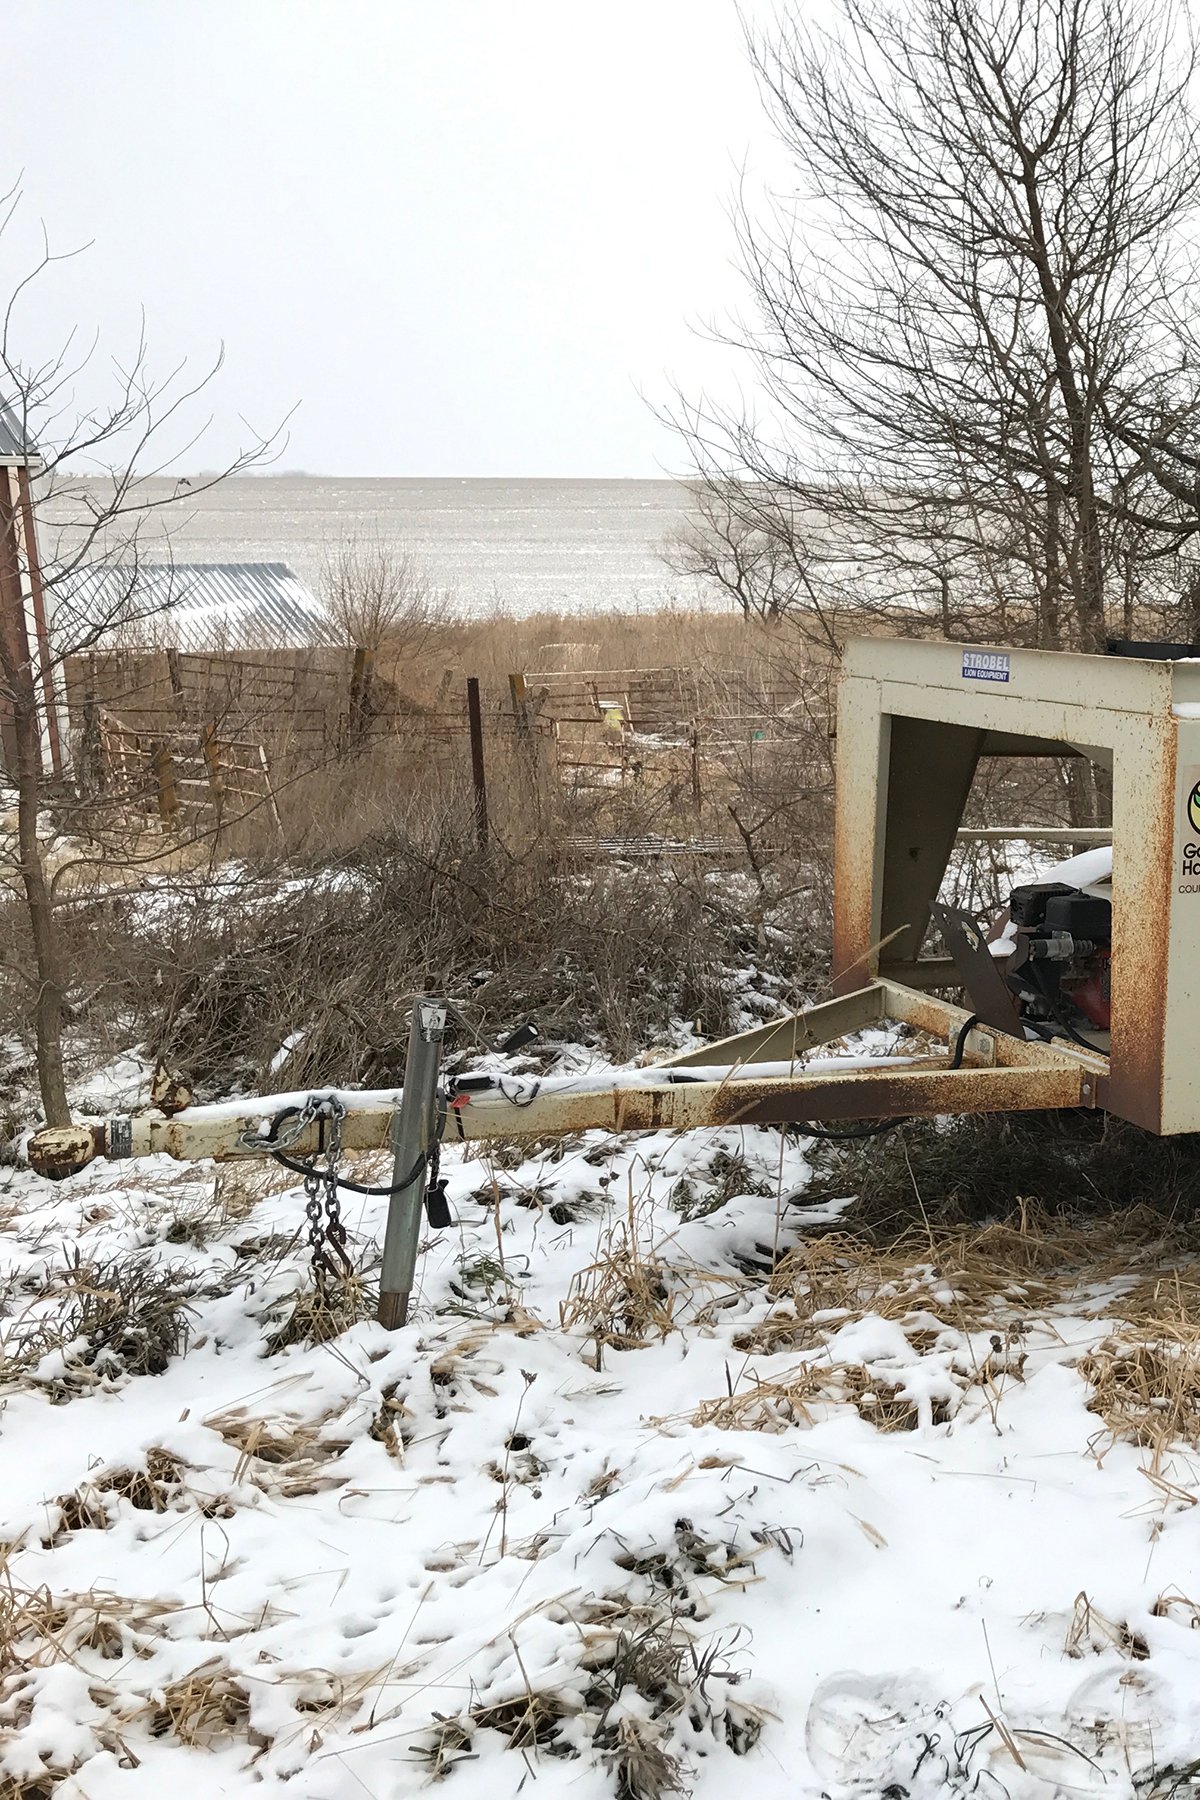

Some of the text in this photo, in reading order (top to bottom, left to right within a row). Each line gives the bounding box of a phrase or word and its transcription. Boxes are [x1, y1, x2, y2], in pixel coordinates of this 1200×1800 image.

[963, 653, 1009, 670] STROBEL
[964, 669, 1007, 680] LION EQUIPMENT
